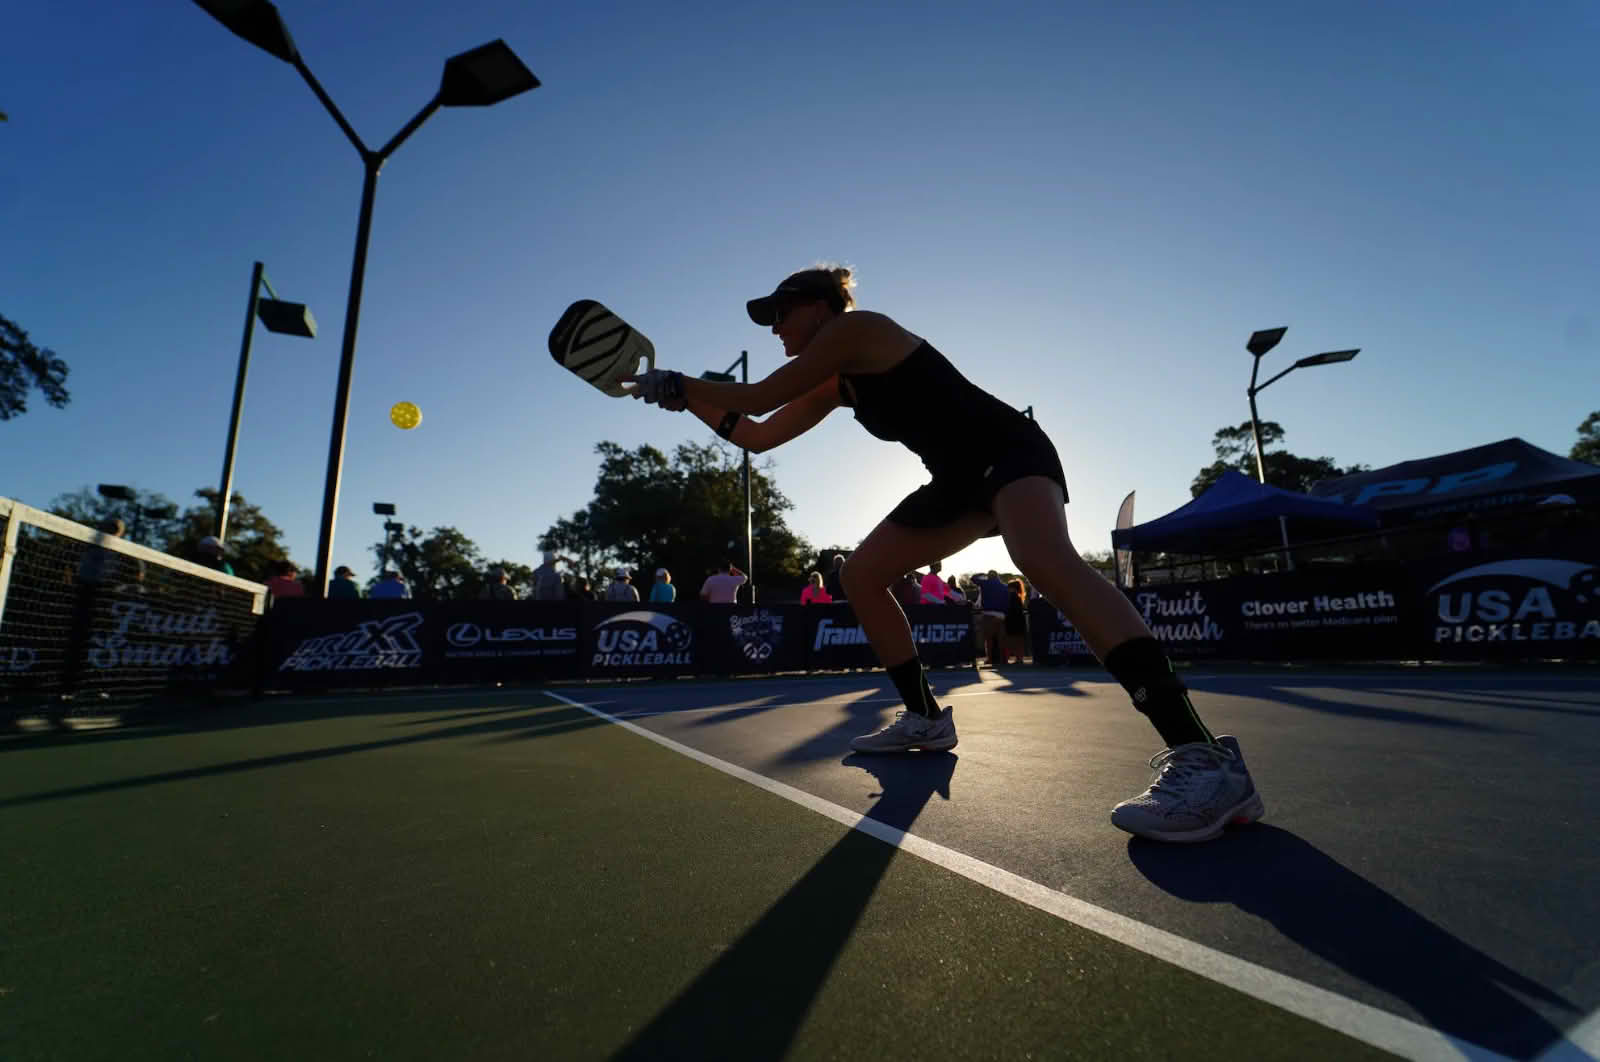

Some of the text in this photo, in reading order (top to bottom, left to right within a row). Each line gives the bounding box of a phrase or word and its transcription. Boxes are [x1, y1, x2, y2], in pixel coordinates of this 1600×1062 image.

[1137, 589, 1208, 617] Fruit
[1240, 590, 1395, 616] Clover Health
[1438, 586, 1558, 624] USA
[112, 600, 217, 633] Fruit
[484, 627, 576, 641] LEXUS
[598, 630, 659, 652] USA
[813, 618, 870, 650] Frank
[1432, 619, 1600, 643] PICKLEBA
[88, 633, 233, 668] Smash
[278, 655, 423, 672] PICKLEBALL
[592, 652, 692, 667] PICKLEBALL
